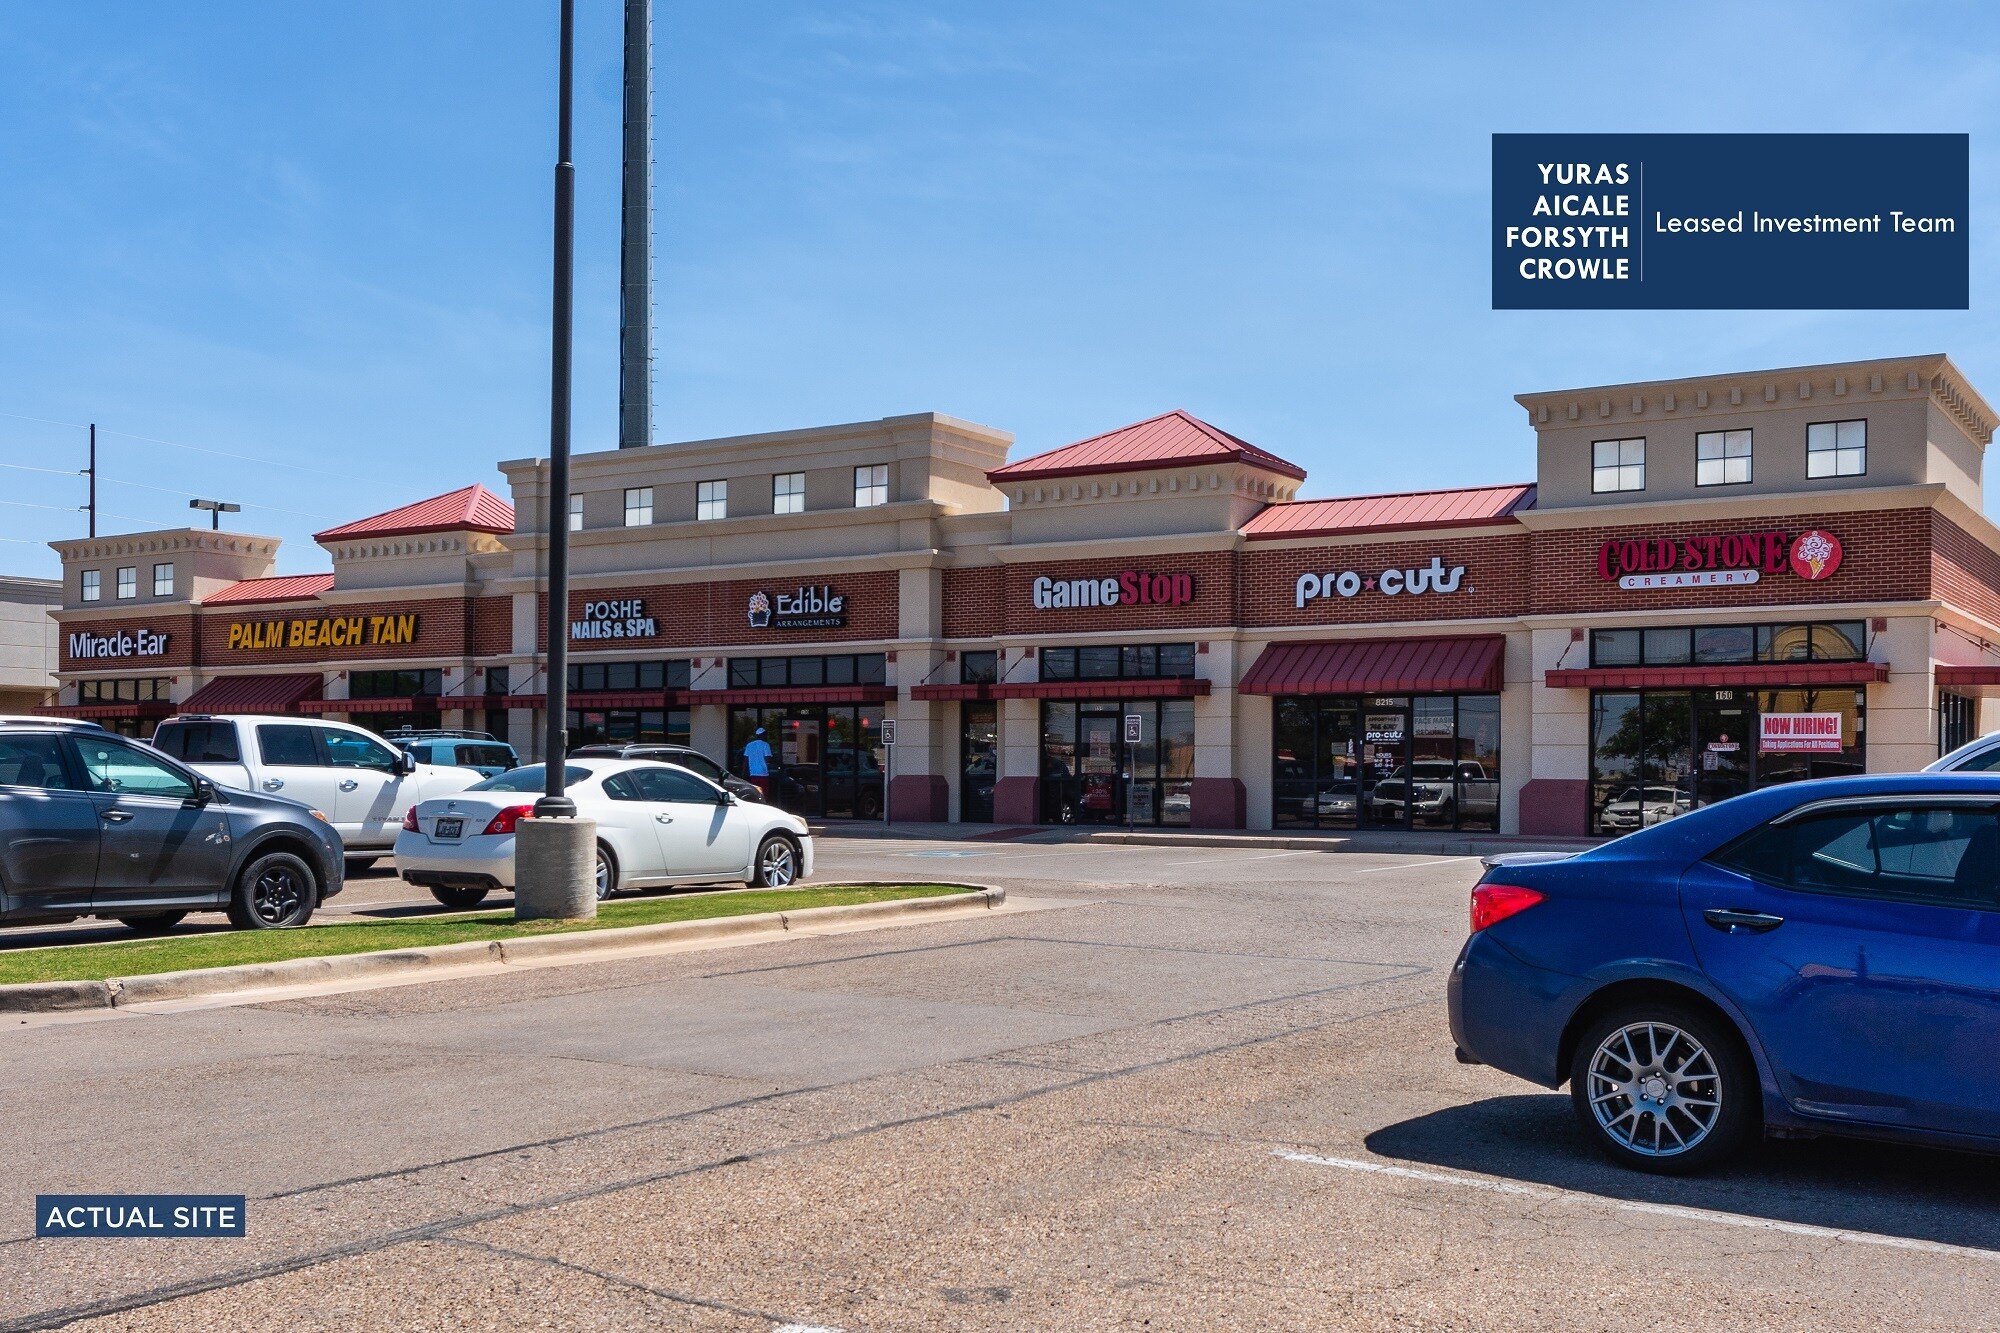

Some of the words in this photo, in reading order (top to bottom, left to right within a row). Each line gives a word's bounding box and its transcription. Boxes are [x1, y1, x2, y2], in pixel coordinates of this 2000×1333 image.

[1598, 539, 1677, 582] COLD
[1682, 531, 1788, 573] STONE
[1628, 573, 1750, 587] CREAMERY
[1033, 570, 1193, 609] GameStop
[585, 600, 643, 619] POSHE
[776, 586, 843, 615] Edible
[776, 618, 841, 627] ARRANGEMENTS
[228, 620, 285, 649] PALM
[289, 617, 363, 645] BEACH
[370, 615, 415, 644] TAN
[1375, 698, 1394, 706] 8215
[1715, 691, 1732, 700] 160
[1764, 717, 1791, 735] NOW
[1793, 717, 1838, 735] HIRING!
